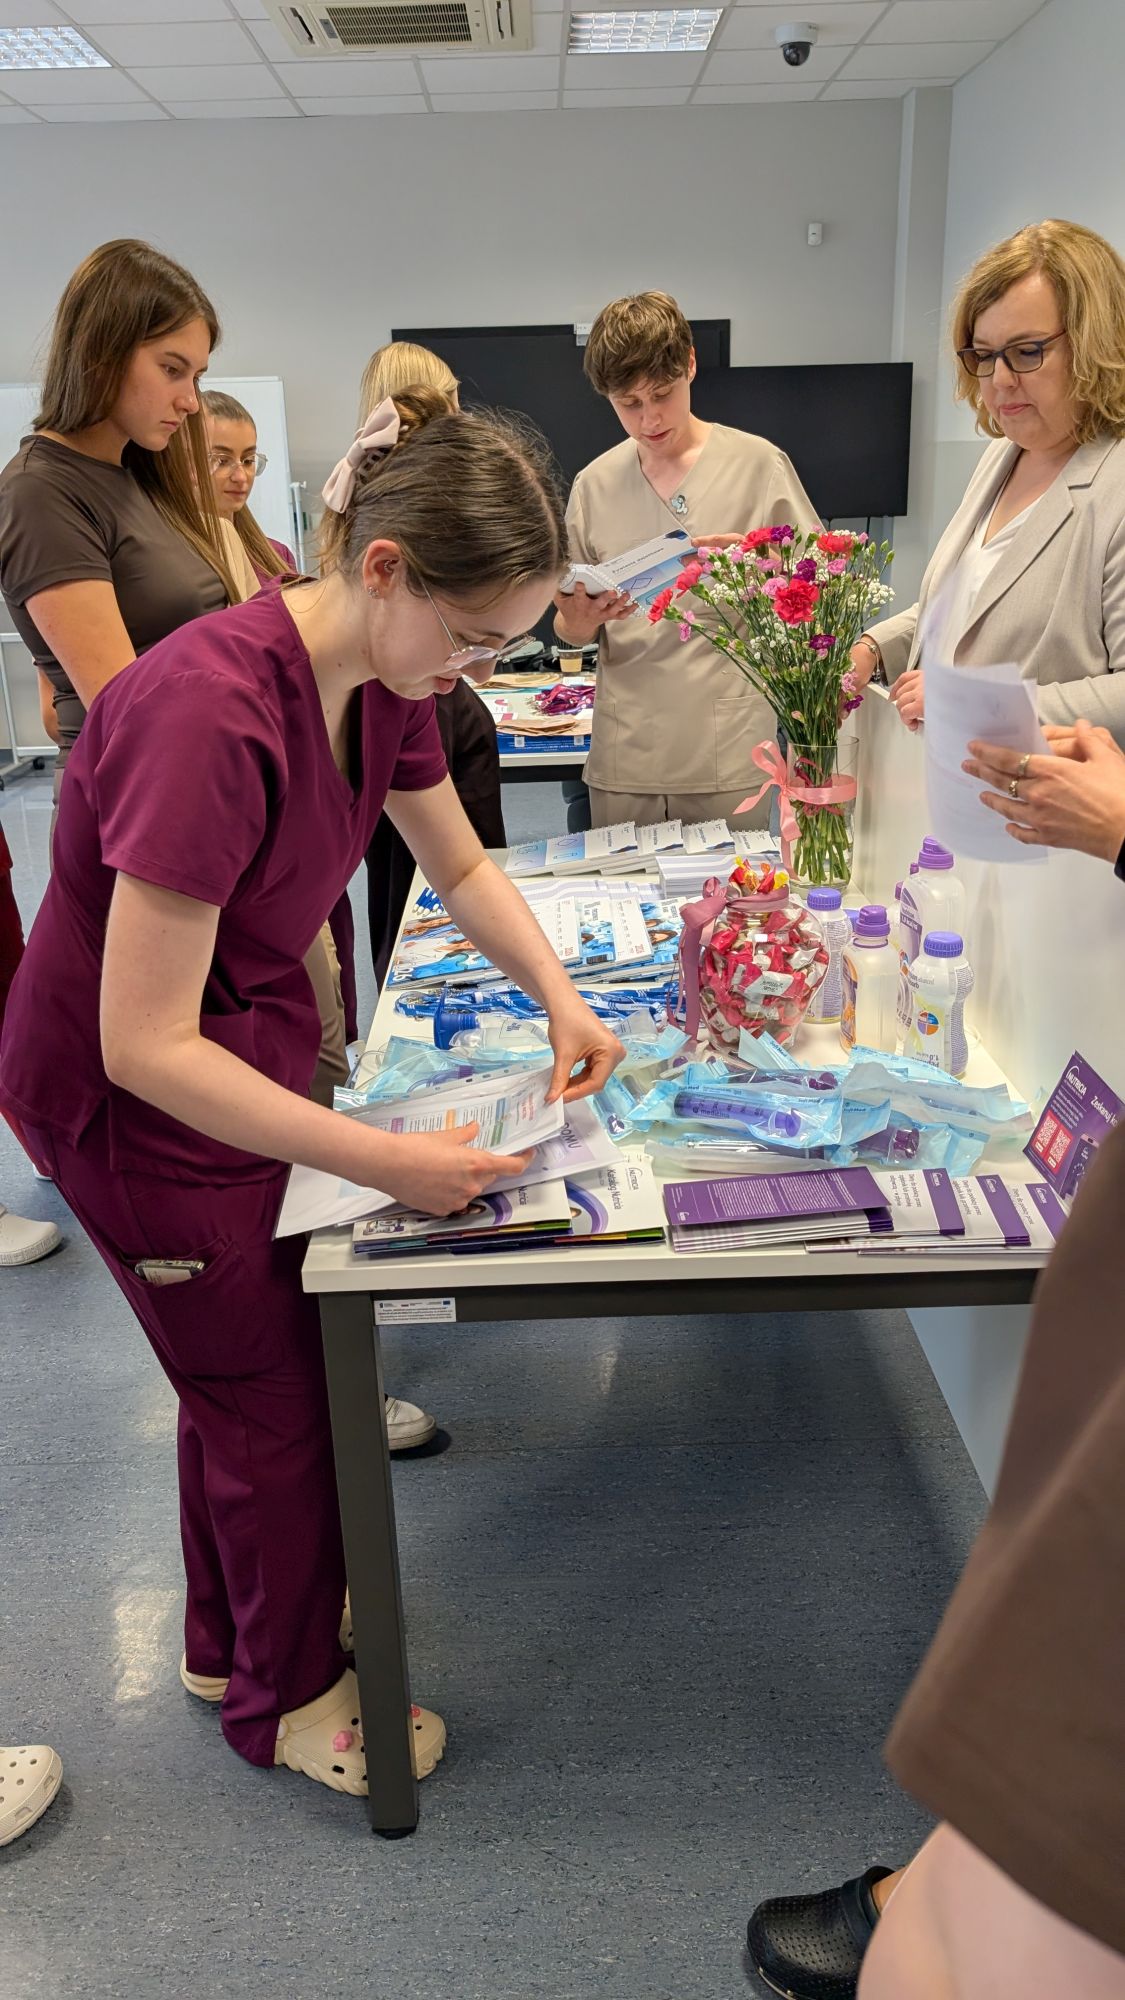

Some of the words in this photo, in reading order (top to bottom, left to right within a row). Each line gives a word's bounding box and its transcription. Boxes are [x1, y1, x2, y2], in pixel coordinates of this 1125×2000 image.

[1091, 1096, 1112, 1123] Zeskanuj
[562, 1122, 582, 1150] DOMU
[606, 1168, 618, 1192] Katalog
[612, 1191, 622, 1210] Nutricia
